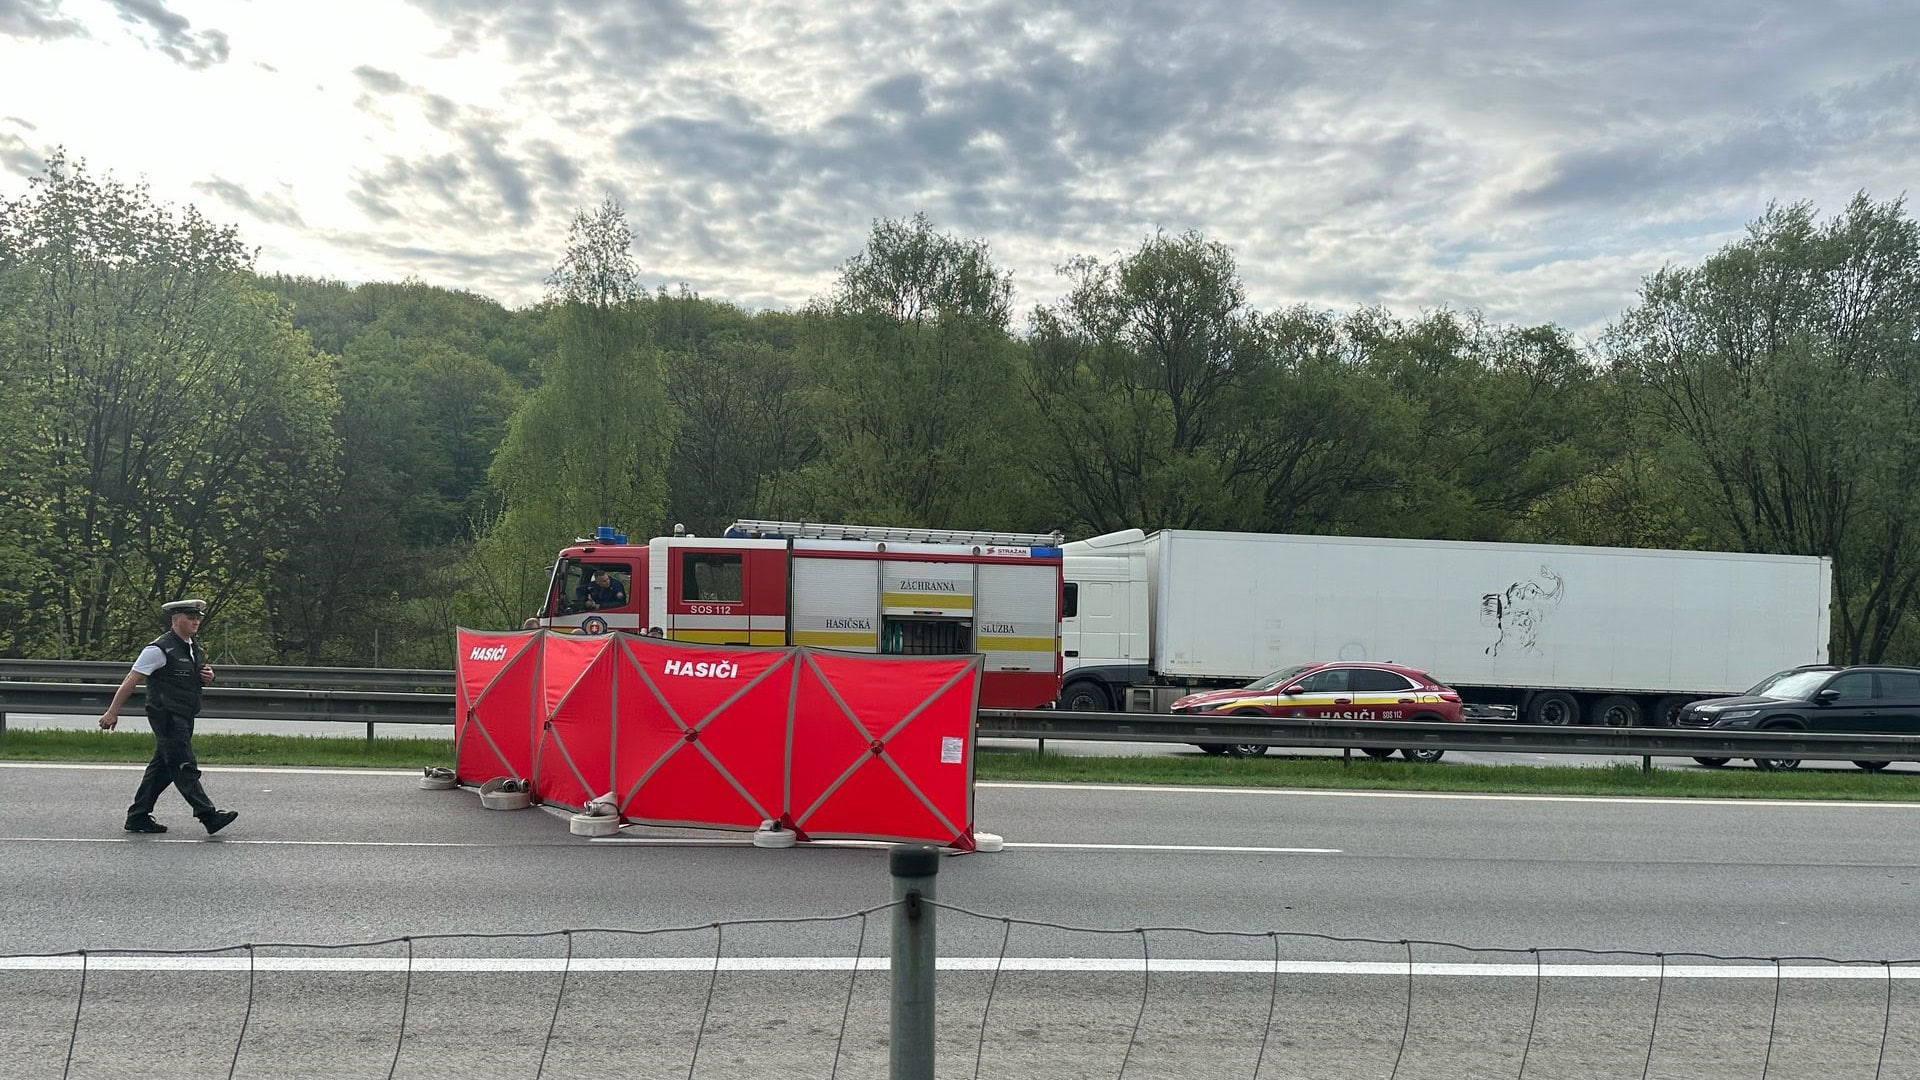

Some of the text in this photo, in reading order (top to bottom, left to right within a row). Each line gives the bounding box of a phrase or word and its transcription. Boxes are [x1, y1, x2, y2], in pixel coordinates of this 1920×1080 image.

[690, 605, 731, 615] SOS 112
[826, 617, 871, 629] HASIČSKÁ
[981, 622, 1015, 634] SLUŽBA
[470, 645, 508, 661] HASIČI
[664, 660, 738, 679] HASIČI
[1394, 710, 1402, 719] 112
